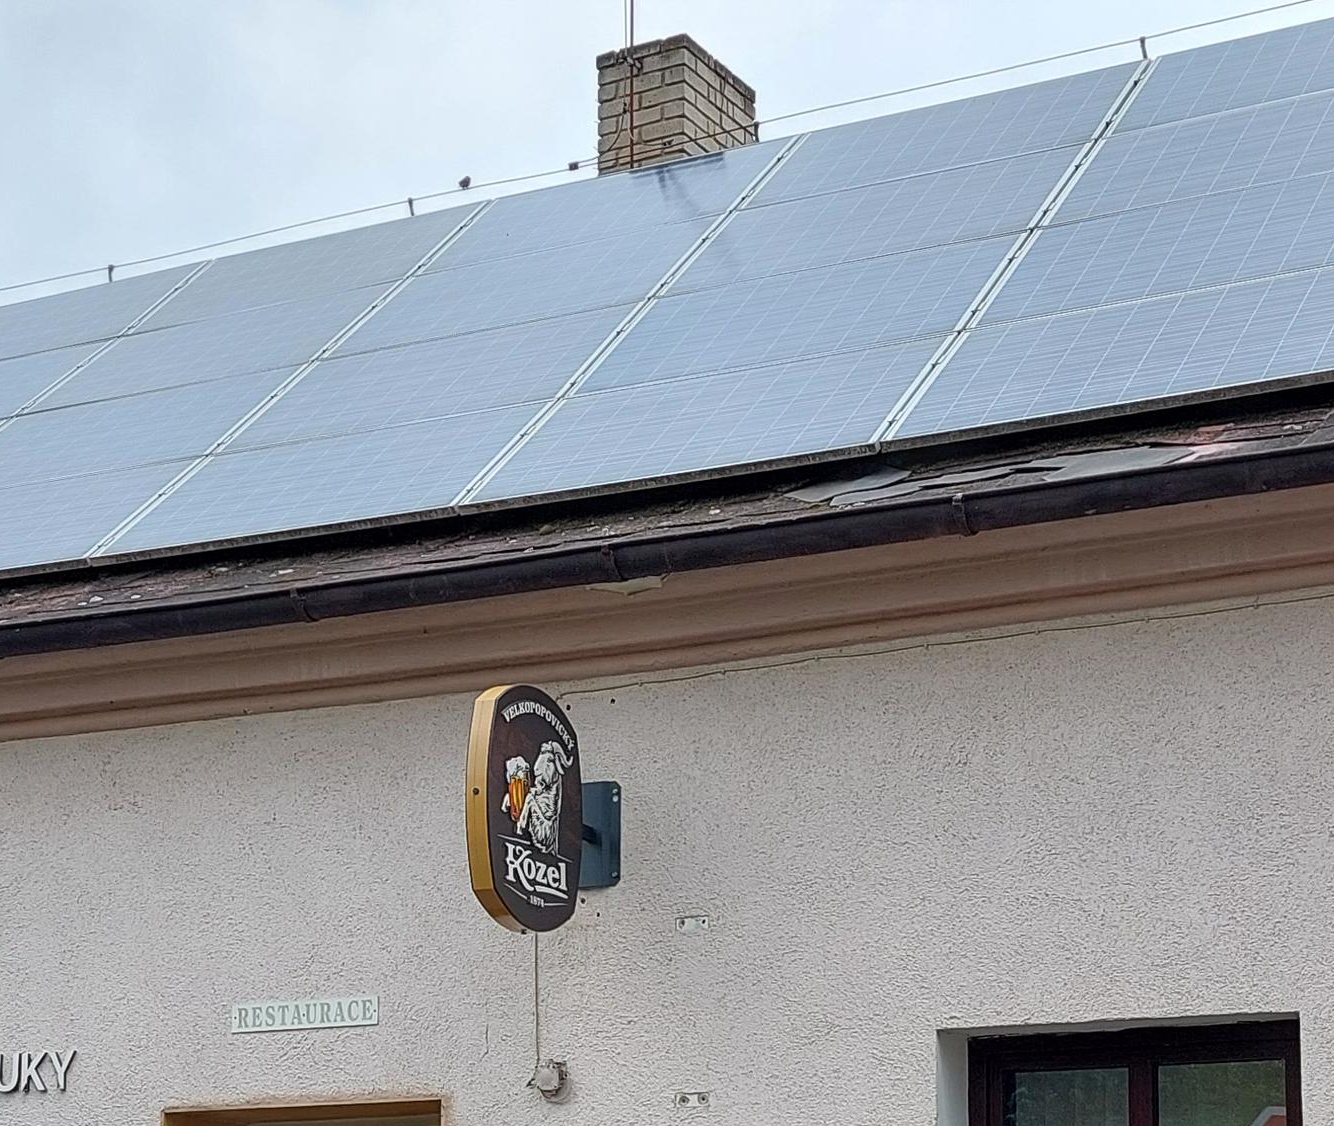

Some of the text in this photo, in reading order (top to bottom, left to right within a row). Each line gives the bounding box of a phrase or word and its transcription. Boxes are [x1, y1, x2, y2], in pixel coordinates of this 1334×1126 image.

[502, 701, 575, 751] VELKOPOPOVICKÝ
[505, 842, 568, 892] Kozel
[237, 999, 374, 1029] RESTAURACE
